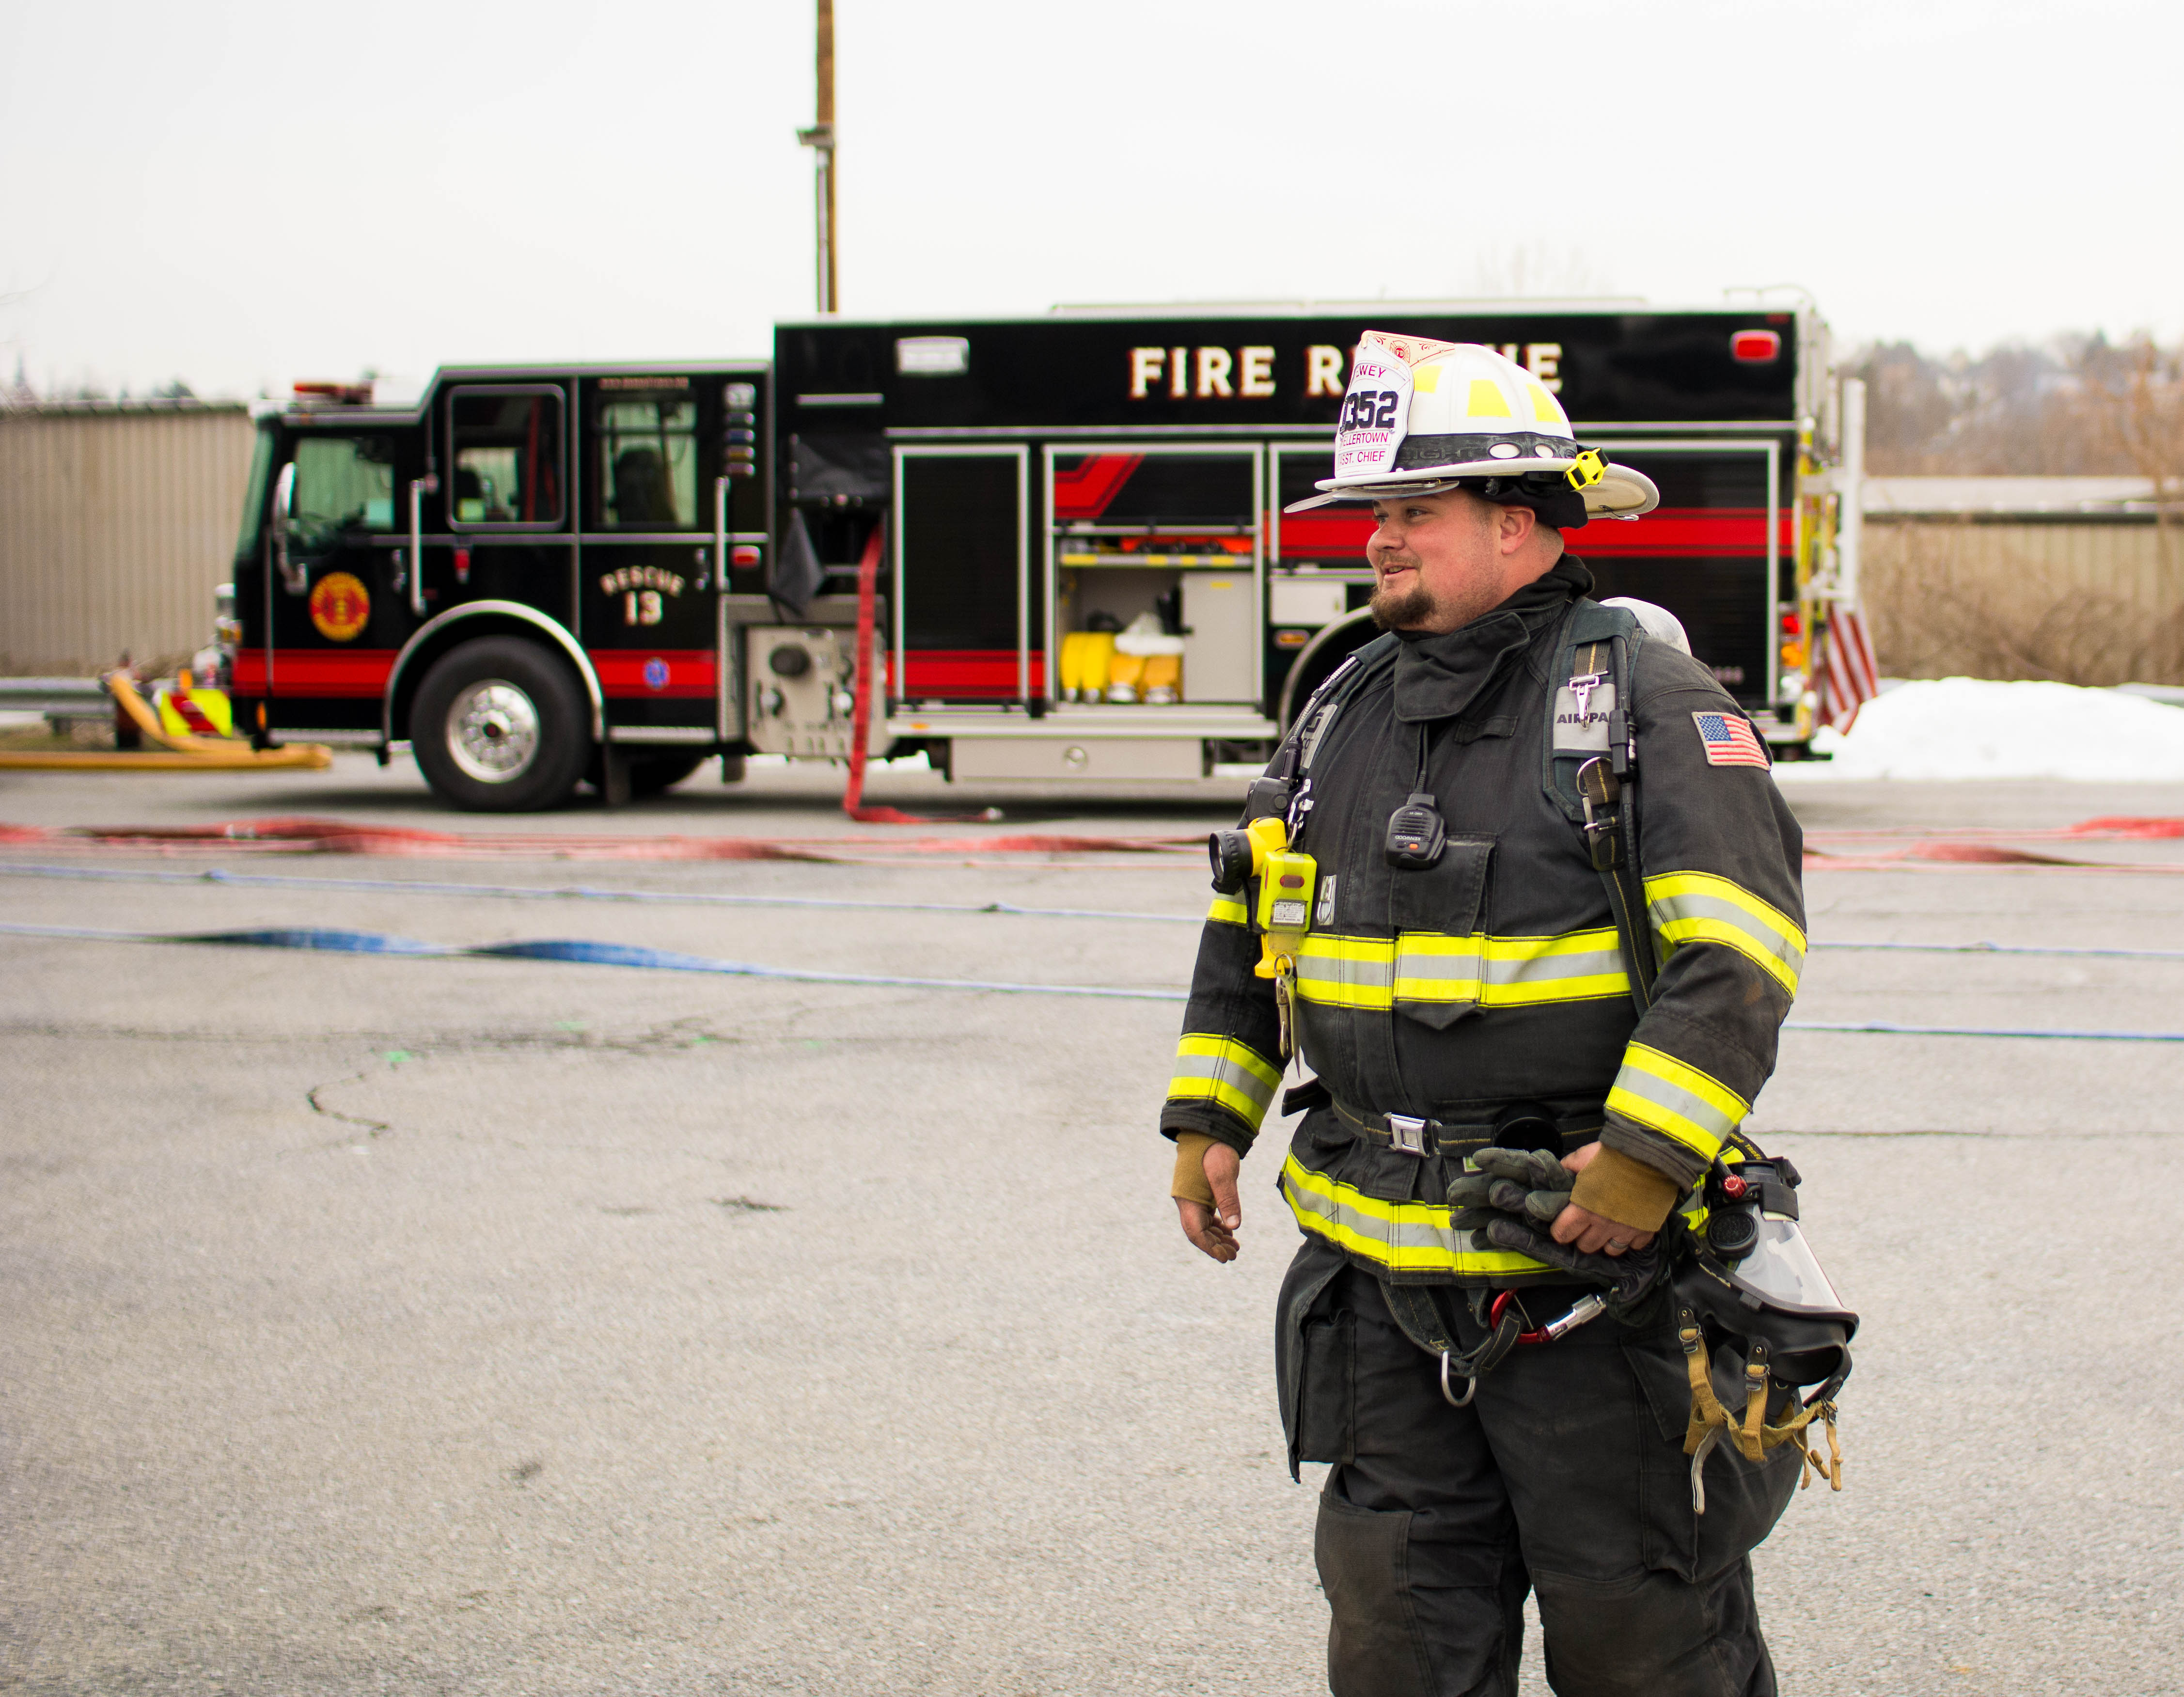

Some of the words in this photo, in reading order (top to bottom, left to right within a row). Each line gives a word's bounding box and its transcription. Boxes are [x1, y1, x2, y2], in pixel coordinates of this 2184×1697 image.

[1127, 346, 1276, 399] FIRE
[1341, 432, 1389, 446] ELLERTOWN
[1357, 451, 1386, 463] CHIEF
[624, 590, 663, 626] 13
